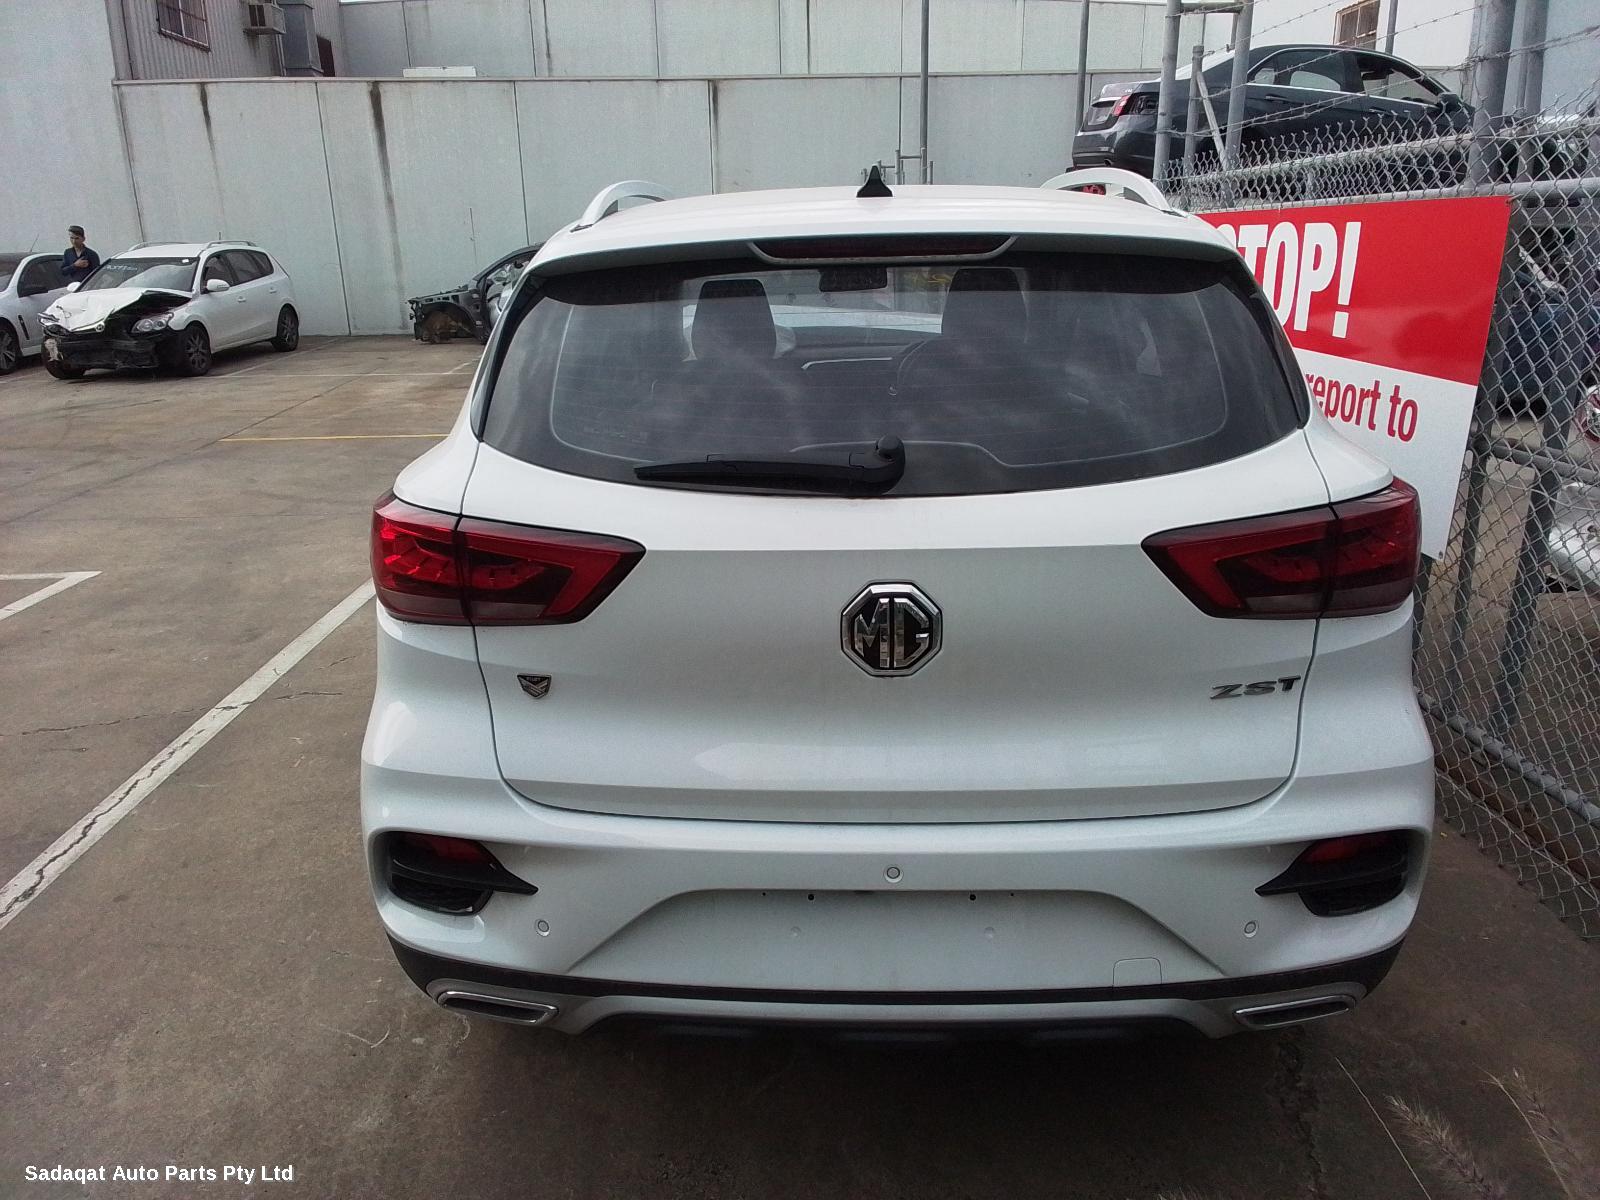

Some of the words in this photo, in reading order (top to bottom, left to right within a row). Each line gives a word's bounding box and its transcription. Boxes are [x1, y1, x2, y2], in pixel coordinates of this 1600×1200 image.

[1216, 221, 1362, 339] TOP!
[1387, 385, 1418, 442] to
[854, 597, 930, 668] MG
[1210, 675, 1301, 700] ZST
